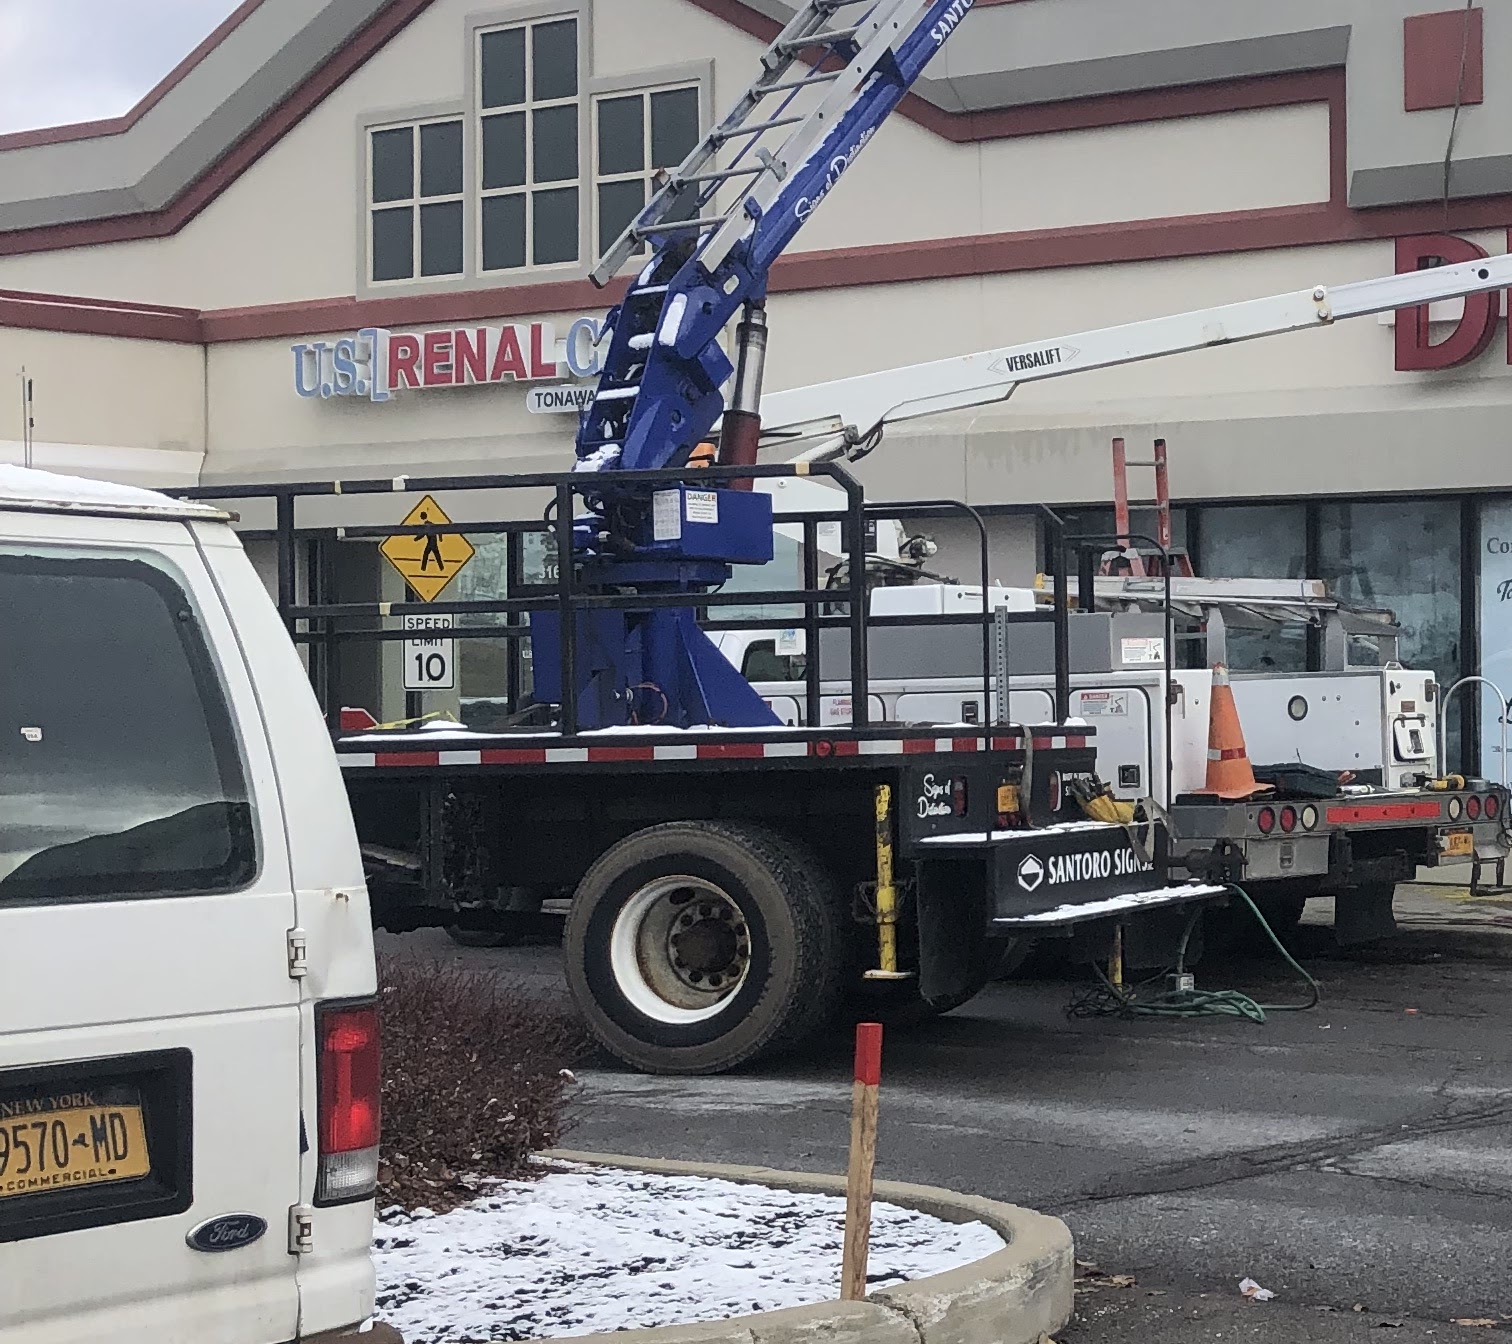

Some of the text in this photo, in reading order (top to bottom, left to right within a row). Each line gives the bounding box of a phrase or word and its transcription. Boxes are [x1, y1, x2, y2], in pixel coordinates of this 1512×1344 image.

[388, 321, 558, 389] RENAL
[1005, 347, 1062, 373] VERSALIFT
[534, 389, 596, 408] TONAWA
[407, 617, 451, 629] SPEED
[414, 652, 446, 682] 10
[1048, 850, 1110, 885] SANTORO
[0, 1091, 95, 1118] NEW YORK
[7, 1168, 108, 1192] COMMERCIAL
[209, 1220, 250, 1243] Ford
